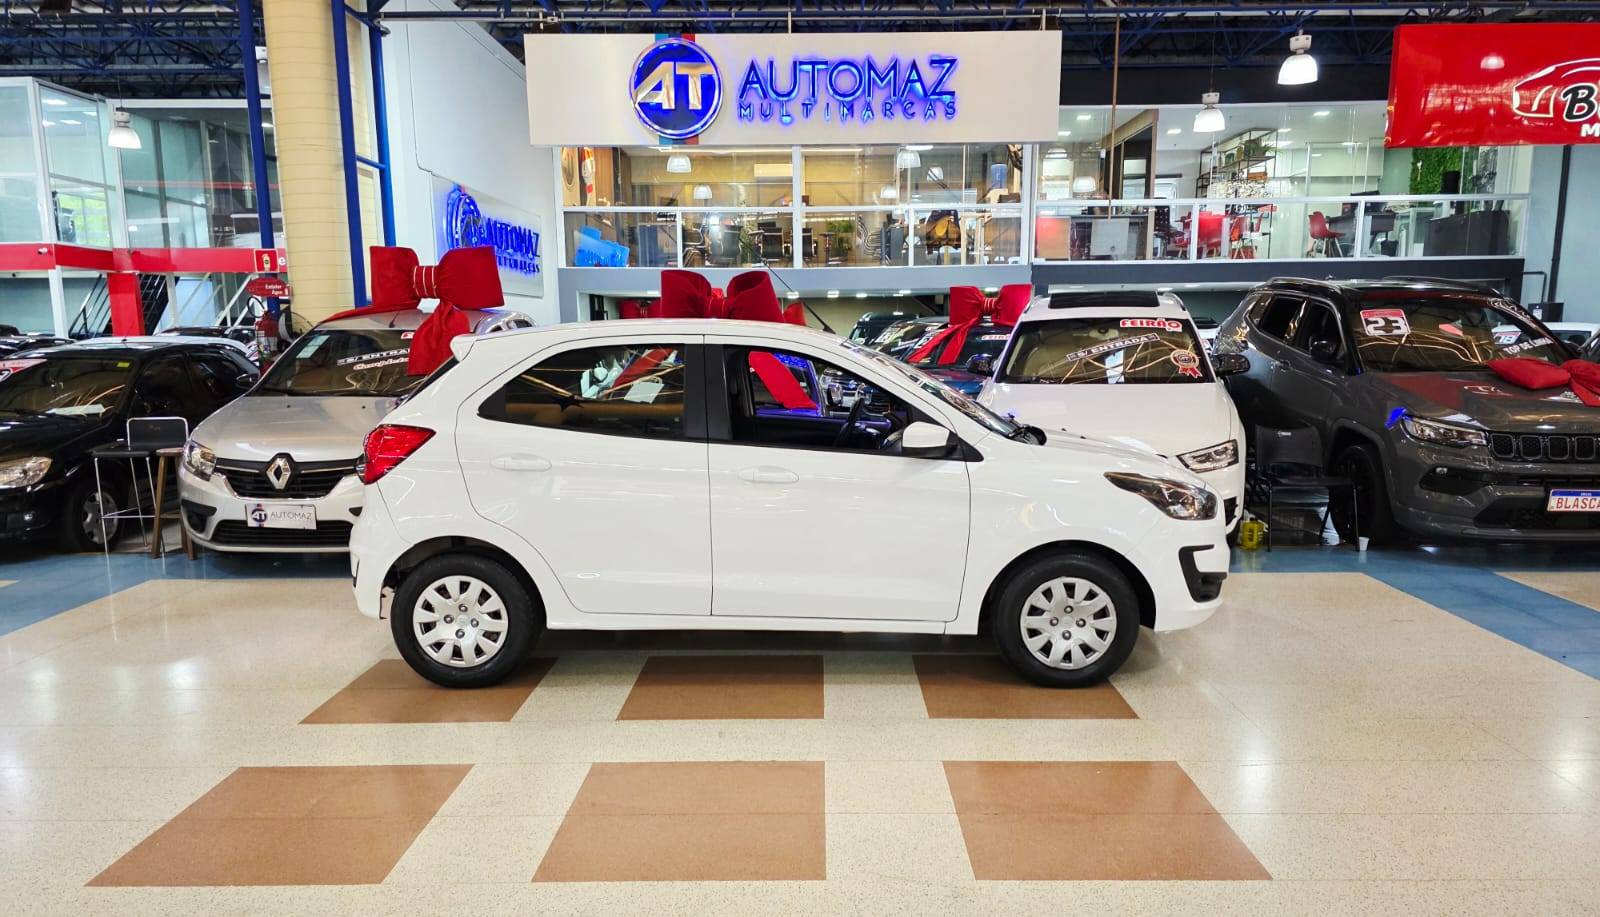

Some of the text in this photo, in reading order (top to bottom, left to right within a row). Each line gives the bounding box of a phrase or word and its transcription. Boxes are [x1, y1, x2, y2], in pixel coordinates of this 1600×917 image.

[738, 57, 958, 100] AUTOMAZ
[738, 101, 957, 120] MULTIMARCAS
[1120, 317, 1182, 331] FEIRÃO
[1090, 336, 1149, 354] ENTRADA
[361, 347, 410, 360] ENTRA
[1556, 497, 1600, 509] BLASC
[270, 511, 312, 520] AUTOMAZ
